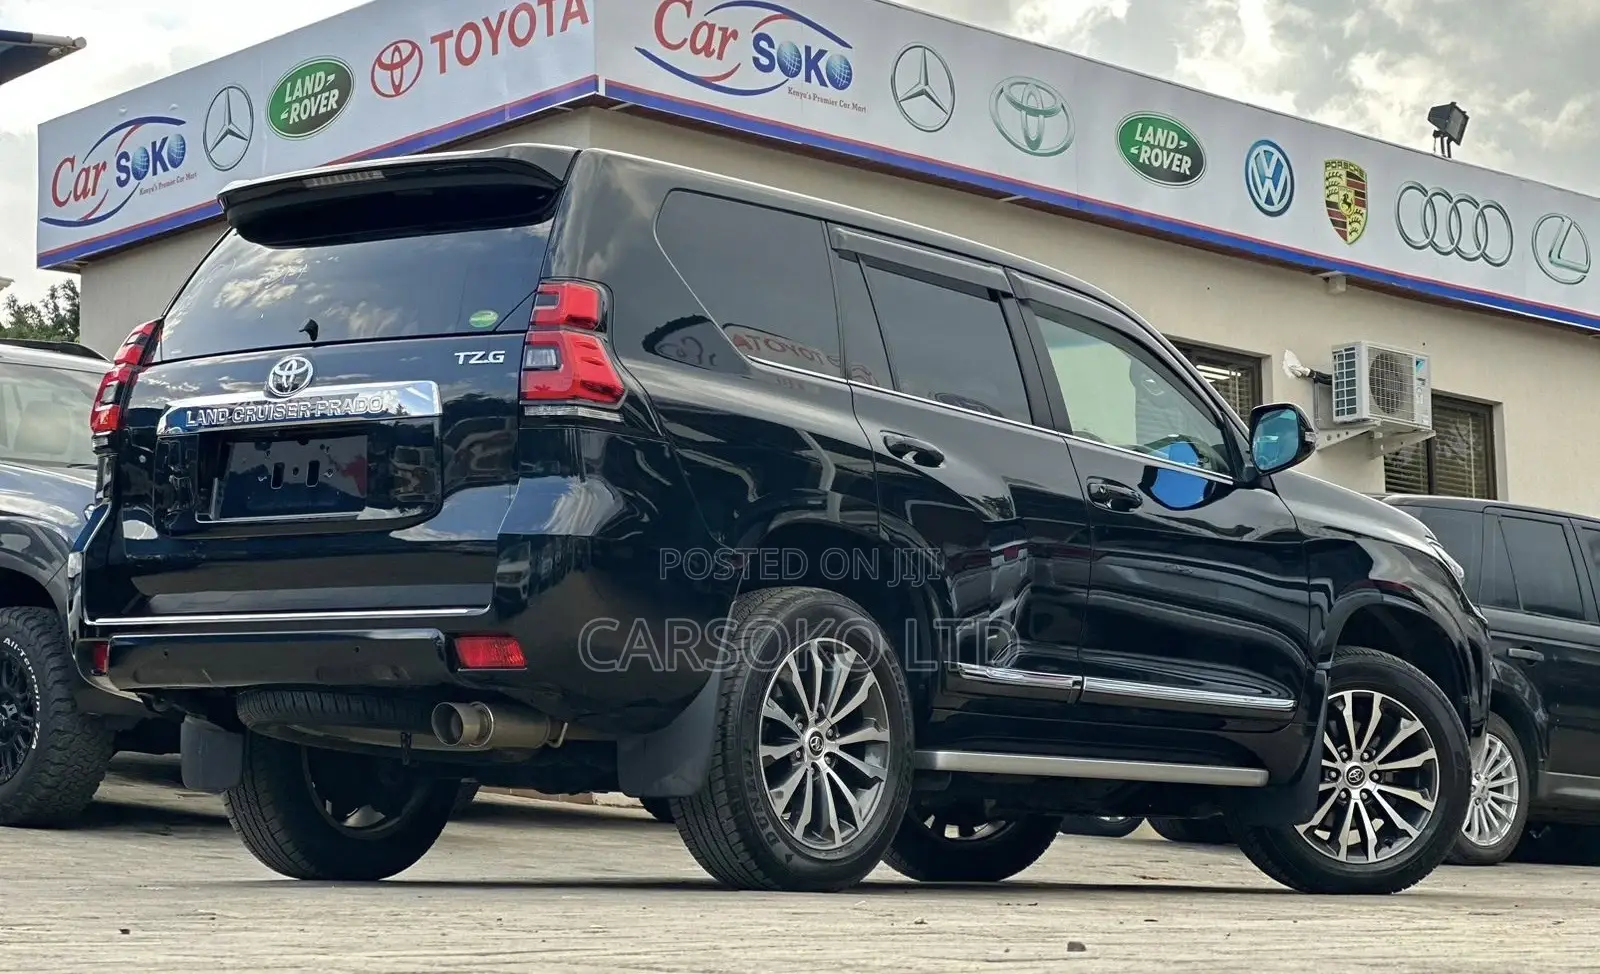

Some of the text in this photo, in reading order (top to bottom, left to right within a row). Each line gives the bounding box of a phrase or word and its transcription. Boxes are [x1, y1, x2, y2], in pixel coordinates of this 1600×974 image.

[430, 0, 590, 75] TOYOTA
[653, 0, 853, 91] Car SOKO
[788, 87, 867, 113] Kenya's Premier Car Mart
[51, 133, 187, 208] Car SOKO
[185, 395, 384, 427] LAND CRUISER PRADO
[3, 637, 41, 712] All-Terrain
